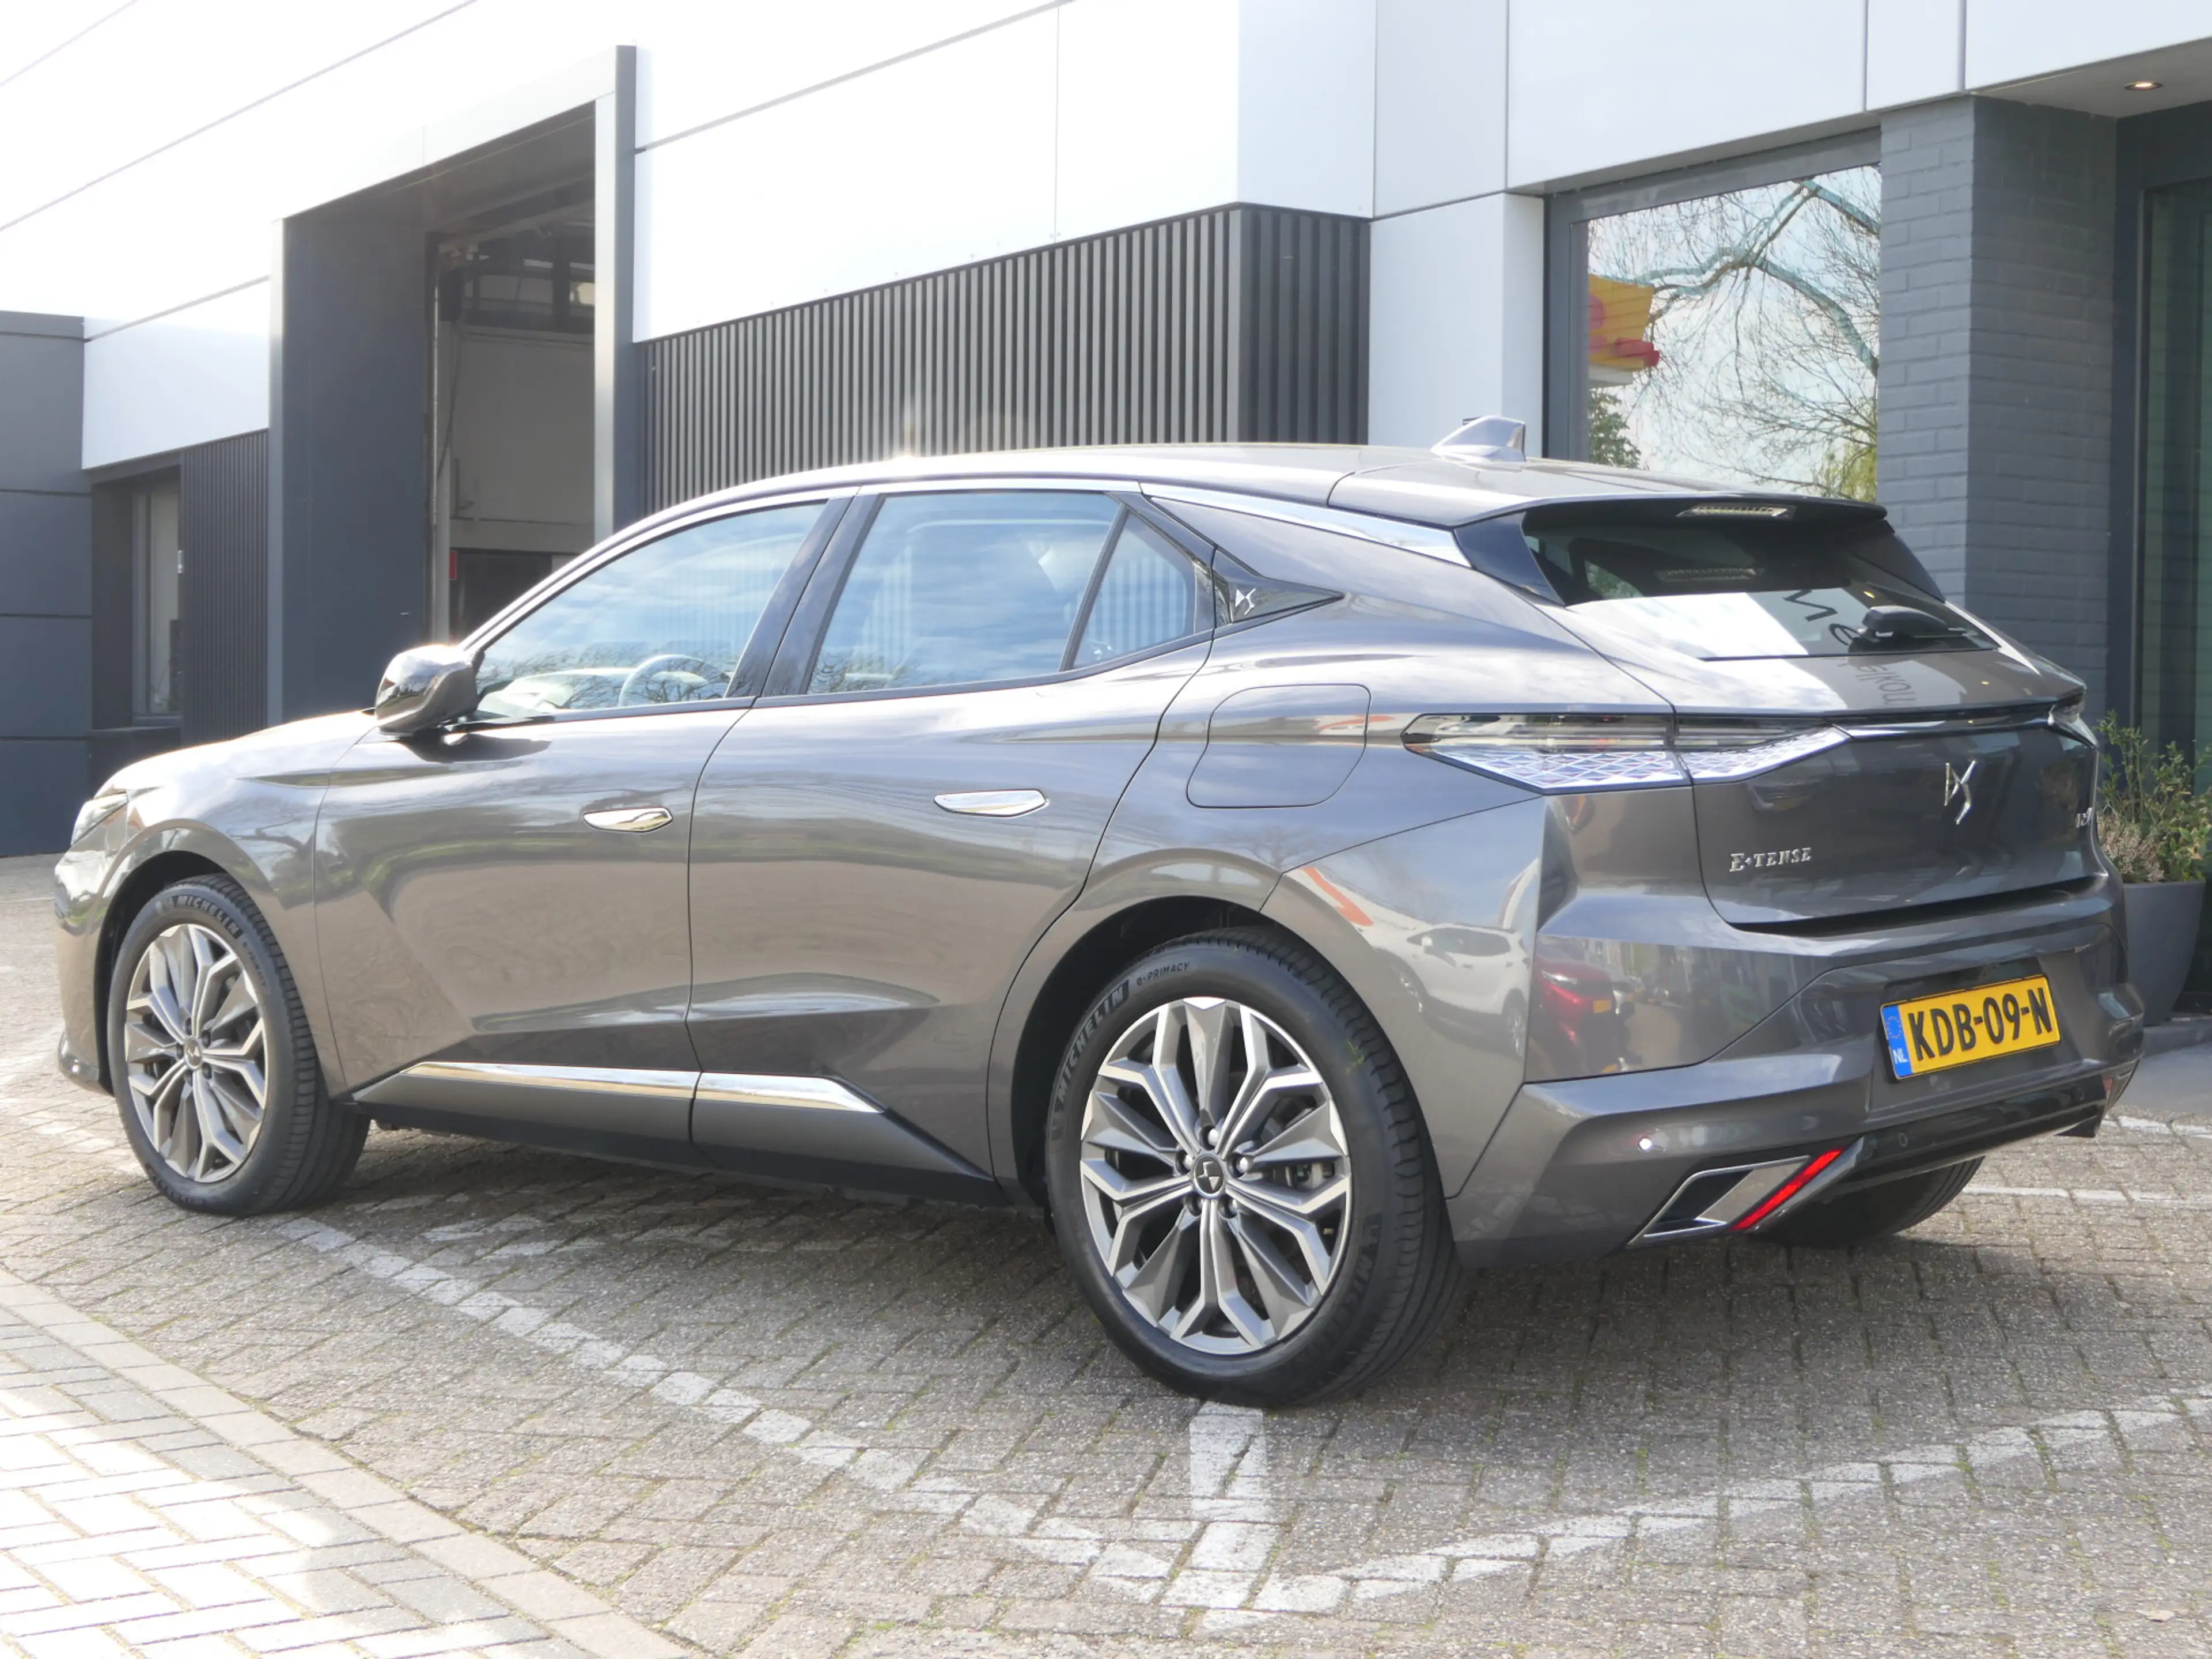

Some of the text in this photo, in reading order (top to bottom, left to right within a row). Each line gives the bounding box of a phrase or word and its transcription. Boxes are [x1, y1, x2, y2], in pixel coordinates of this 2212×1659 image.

[177, 895, 240, 935] MICHELIN
[1056, 984, 1125, 1104] MICHELIN
[1907, 987, 2052, 1062] KDB-09-N
[1892, 1047, 1908, 1064] NL
